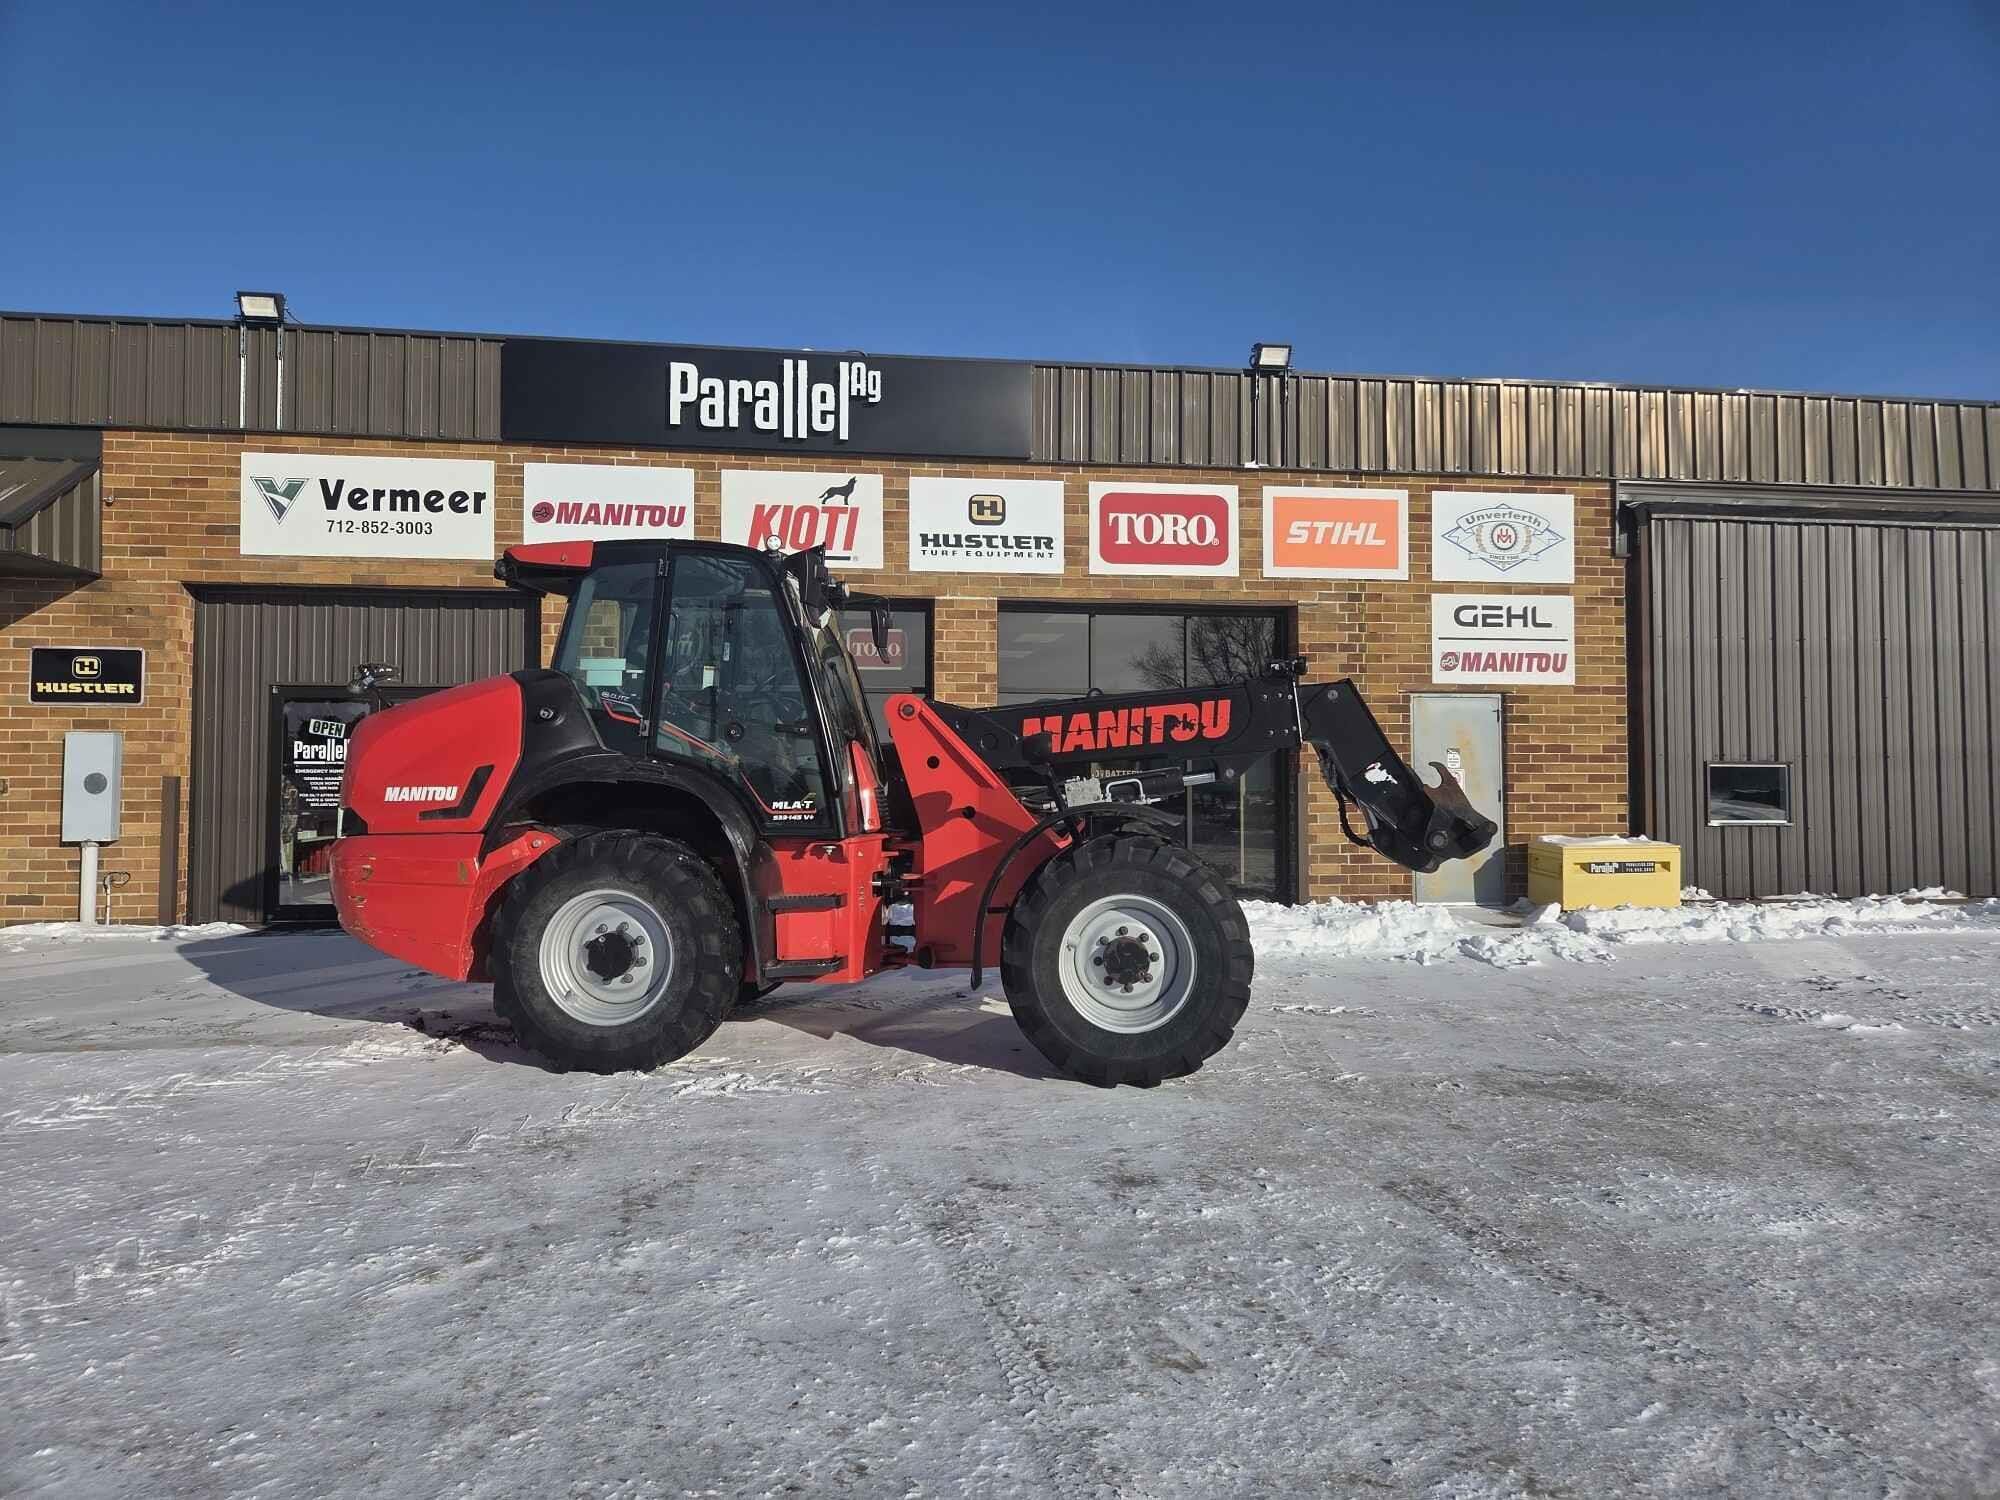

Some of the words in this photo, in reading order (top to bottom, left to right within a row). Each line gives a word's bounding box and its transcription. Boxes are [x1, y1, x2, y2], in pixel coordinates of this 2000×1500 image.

[670, 359, 849, 440] Parallel
[850, 361, 882, 403] Ag
[319, 478, 488, 515] Vermeer
[556, 502, 687, 528] MANITOU
[1465, 511, 1543, 528] Unverferth
[326, 519, 434, 536] 712-852-3003
[749, 503, 860, 552] KIOTI
[1108, 512, 1217, 546] TORO
[1285, 520, 1387, 546] STIHL
[919, 533, 1055, 551] HUSTLER
[921, 549, 958, 557] TURF
[966, 550, 1055, 559] EQUIPMENT
[1453, 604, 1553, 628] GEHL
[853, 642, 900, 657] TOO
[1461, 651, 1568, 673] MANITOU
[36, 682, 135, 694] HUSTLER
[312, 720, 345, 737] OPEN
[1022, 699, 1232, 753] MANITOU
[294, 738, 347, 761] Parallel
[384, 786, 458, 801] MANITOU
